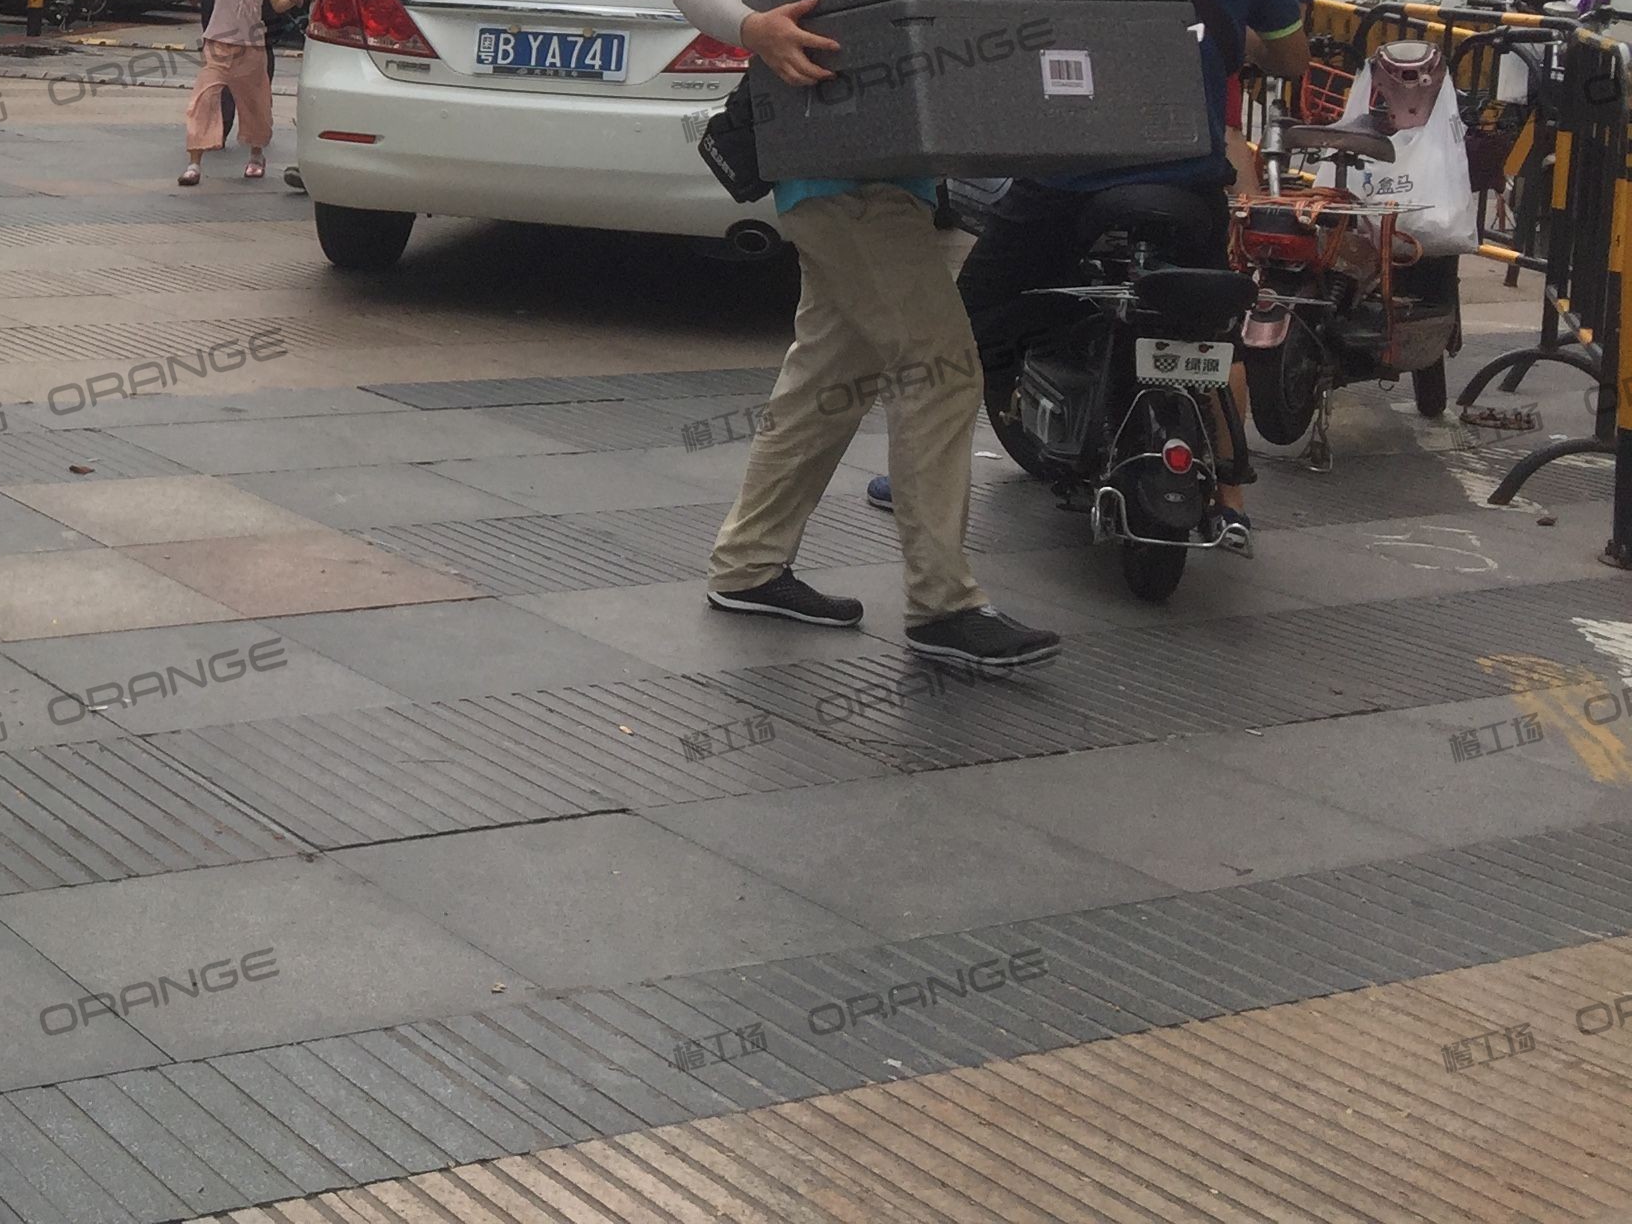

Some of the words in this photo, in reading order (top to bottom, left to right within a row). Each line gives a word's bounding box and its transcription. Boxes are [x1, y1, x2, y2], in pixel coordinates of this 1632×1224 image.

[528, 34, 618, 71] YA741
[1375, 174, 1414, 195] 盒马
[1184, 357, 1220, 373] 绿源
